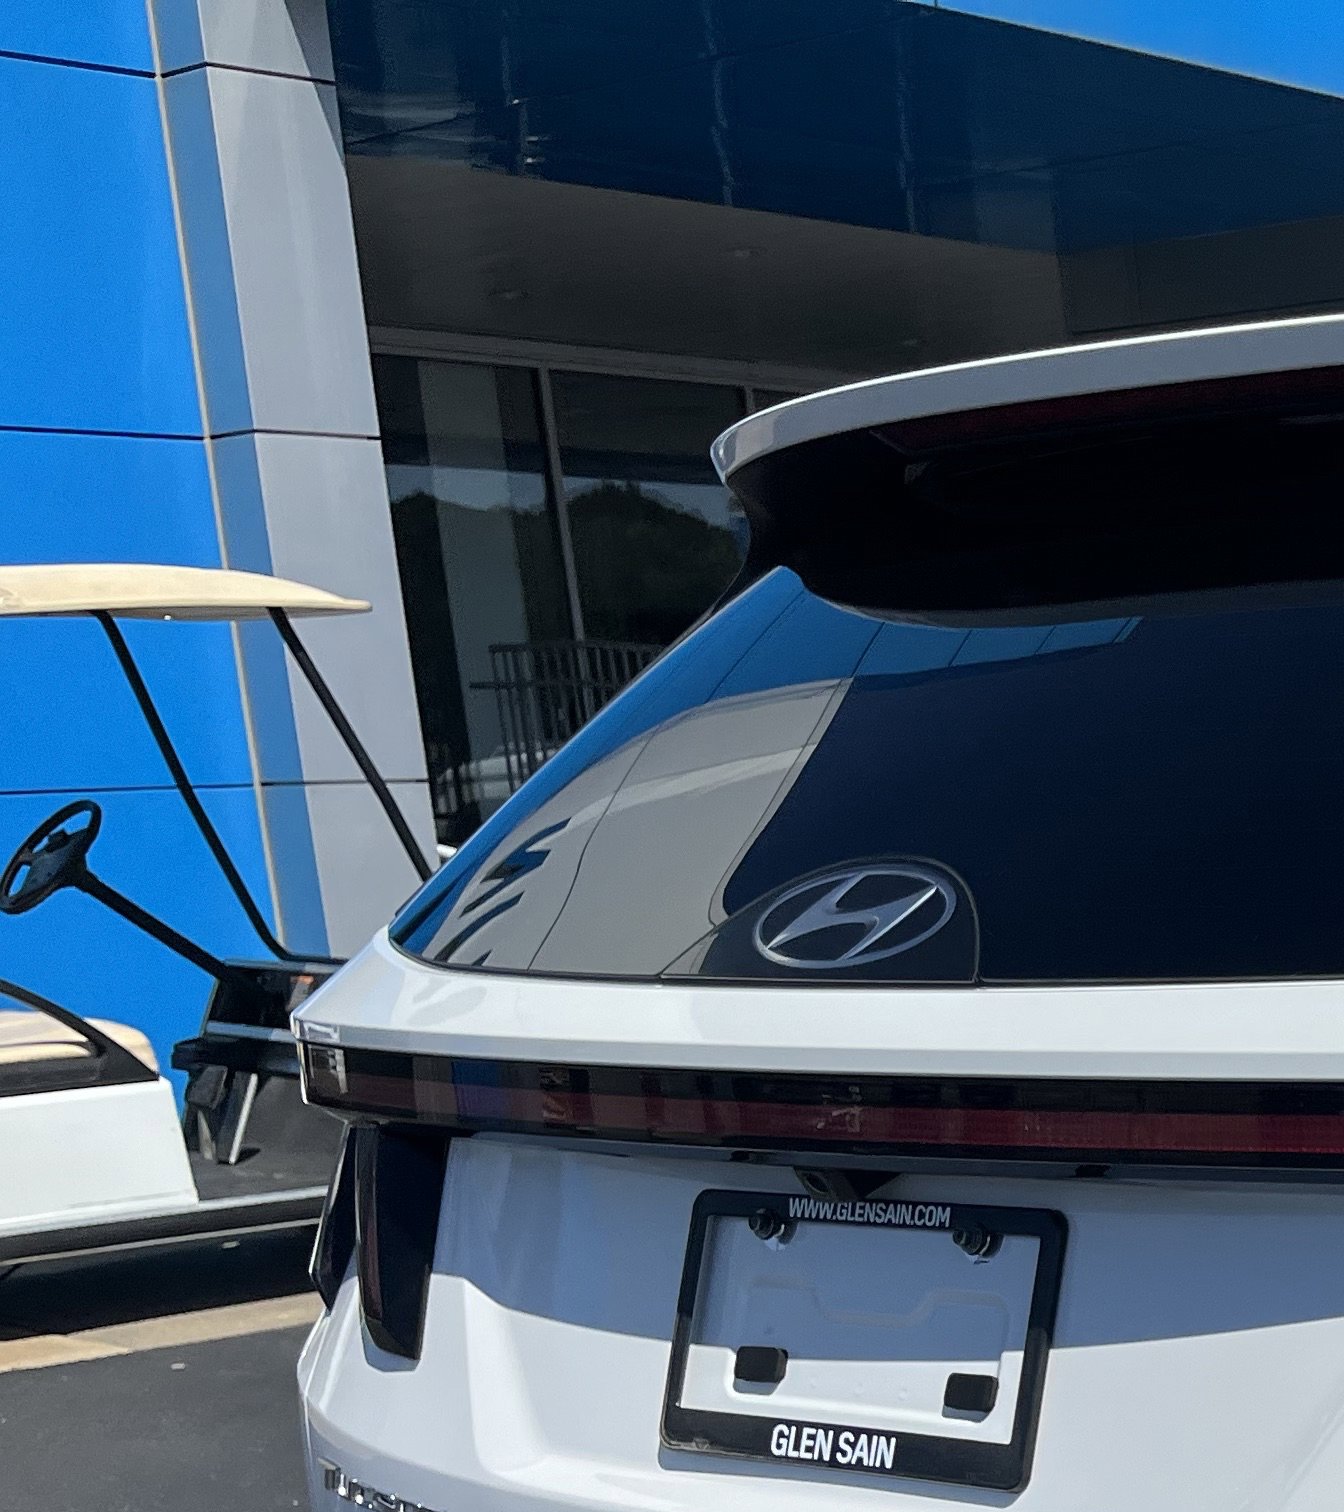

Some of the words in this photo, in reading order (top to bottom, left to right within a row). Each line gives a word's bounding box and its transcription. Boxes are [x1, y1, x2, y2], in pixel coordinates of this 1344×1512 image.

[788, 1196, 951, 1228] WWW.GLENSAIN.COM
[770, 1422, 833, 1462] GLEN
[835, 1430, 897, 1470] SAIN
